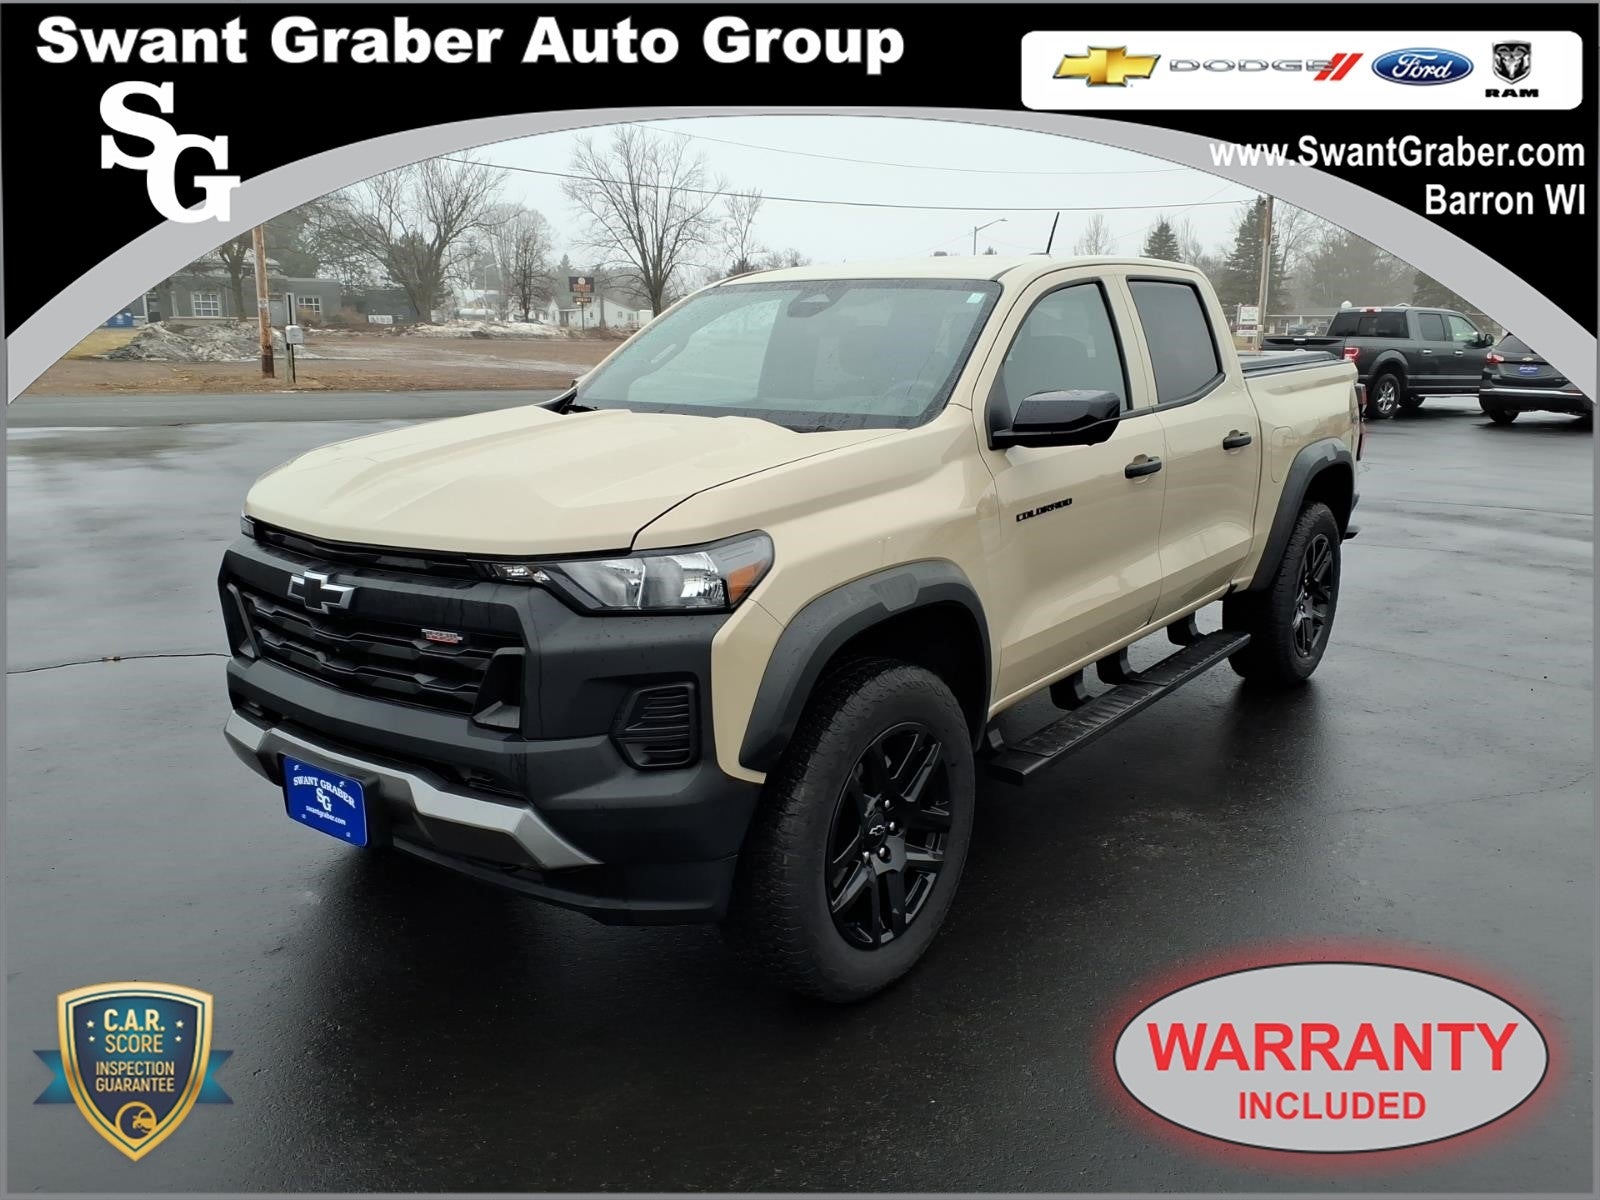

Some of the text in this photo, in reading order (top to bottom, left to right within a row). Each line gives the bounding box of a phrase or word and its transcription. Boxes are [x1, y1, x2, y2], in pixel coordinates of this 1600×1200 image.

[1016, 498, 1072, 522] COLORADO
[293, 776, 356, 808] SWANT GRABER
